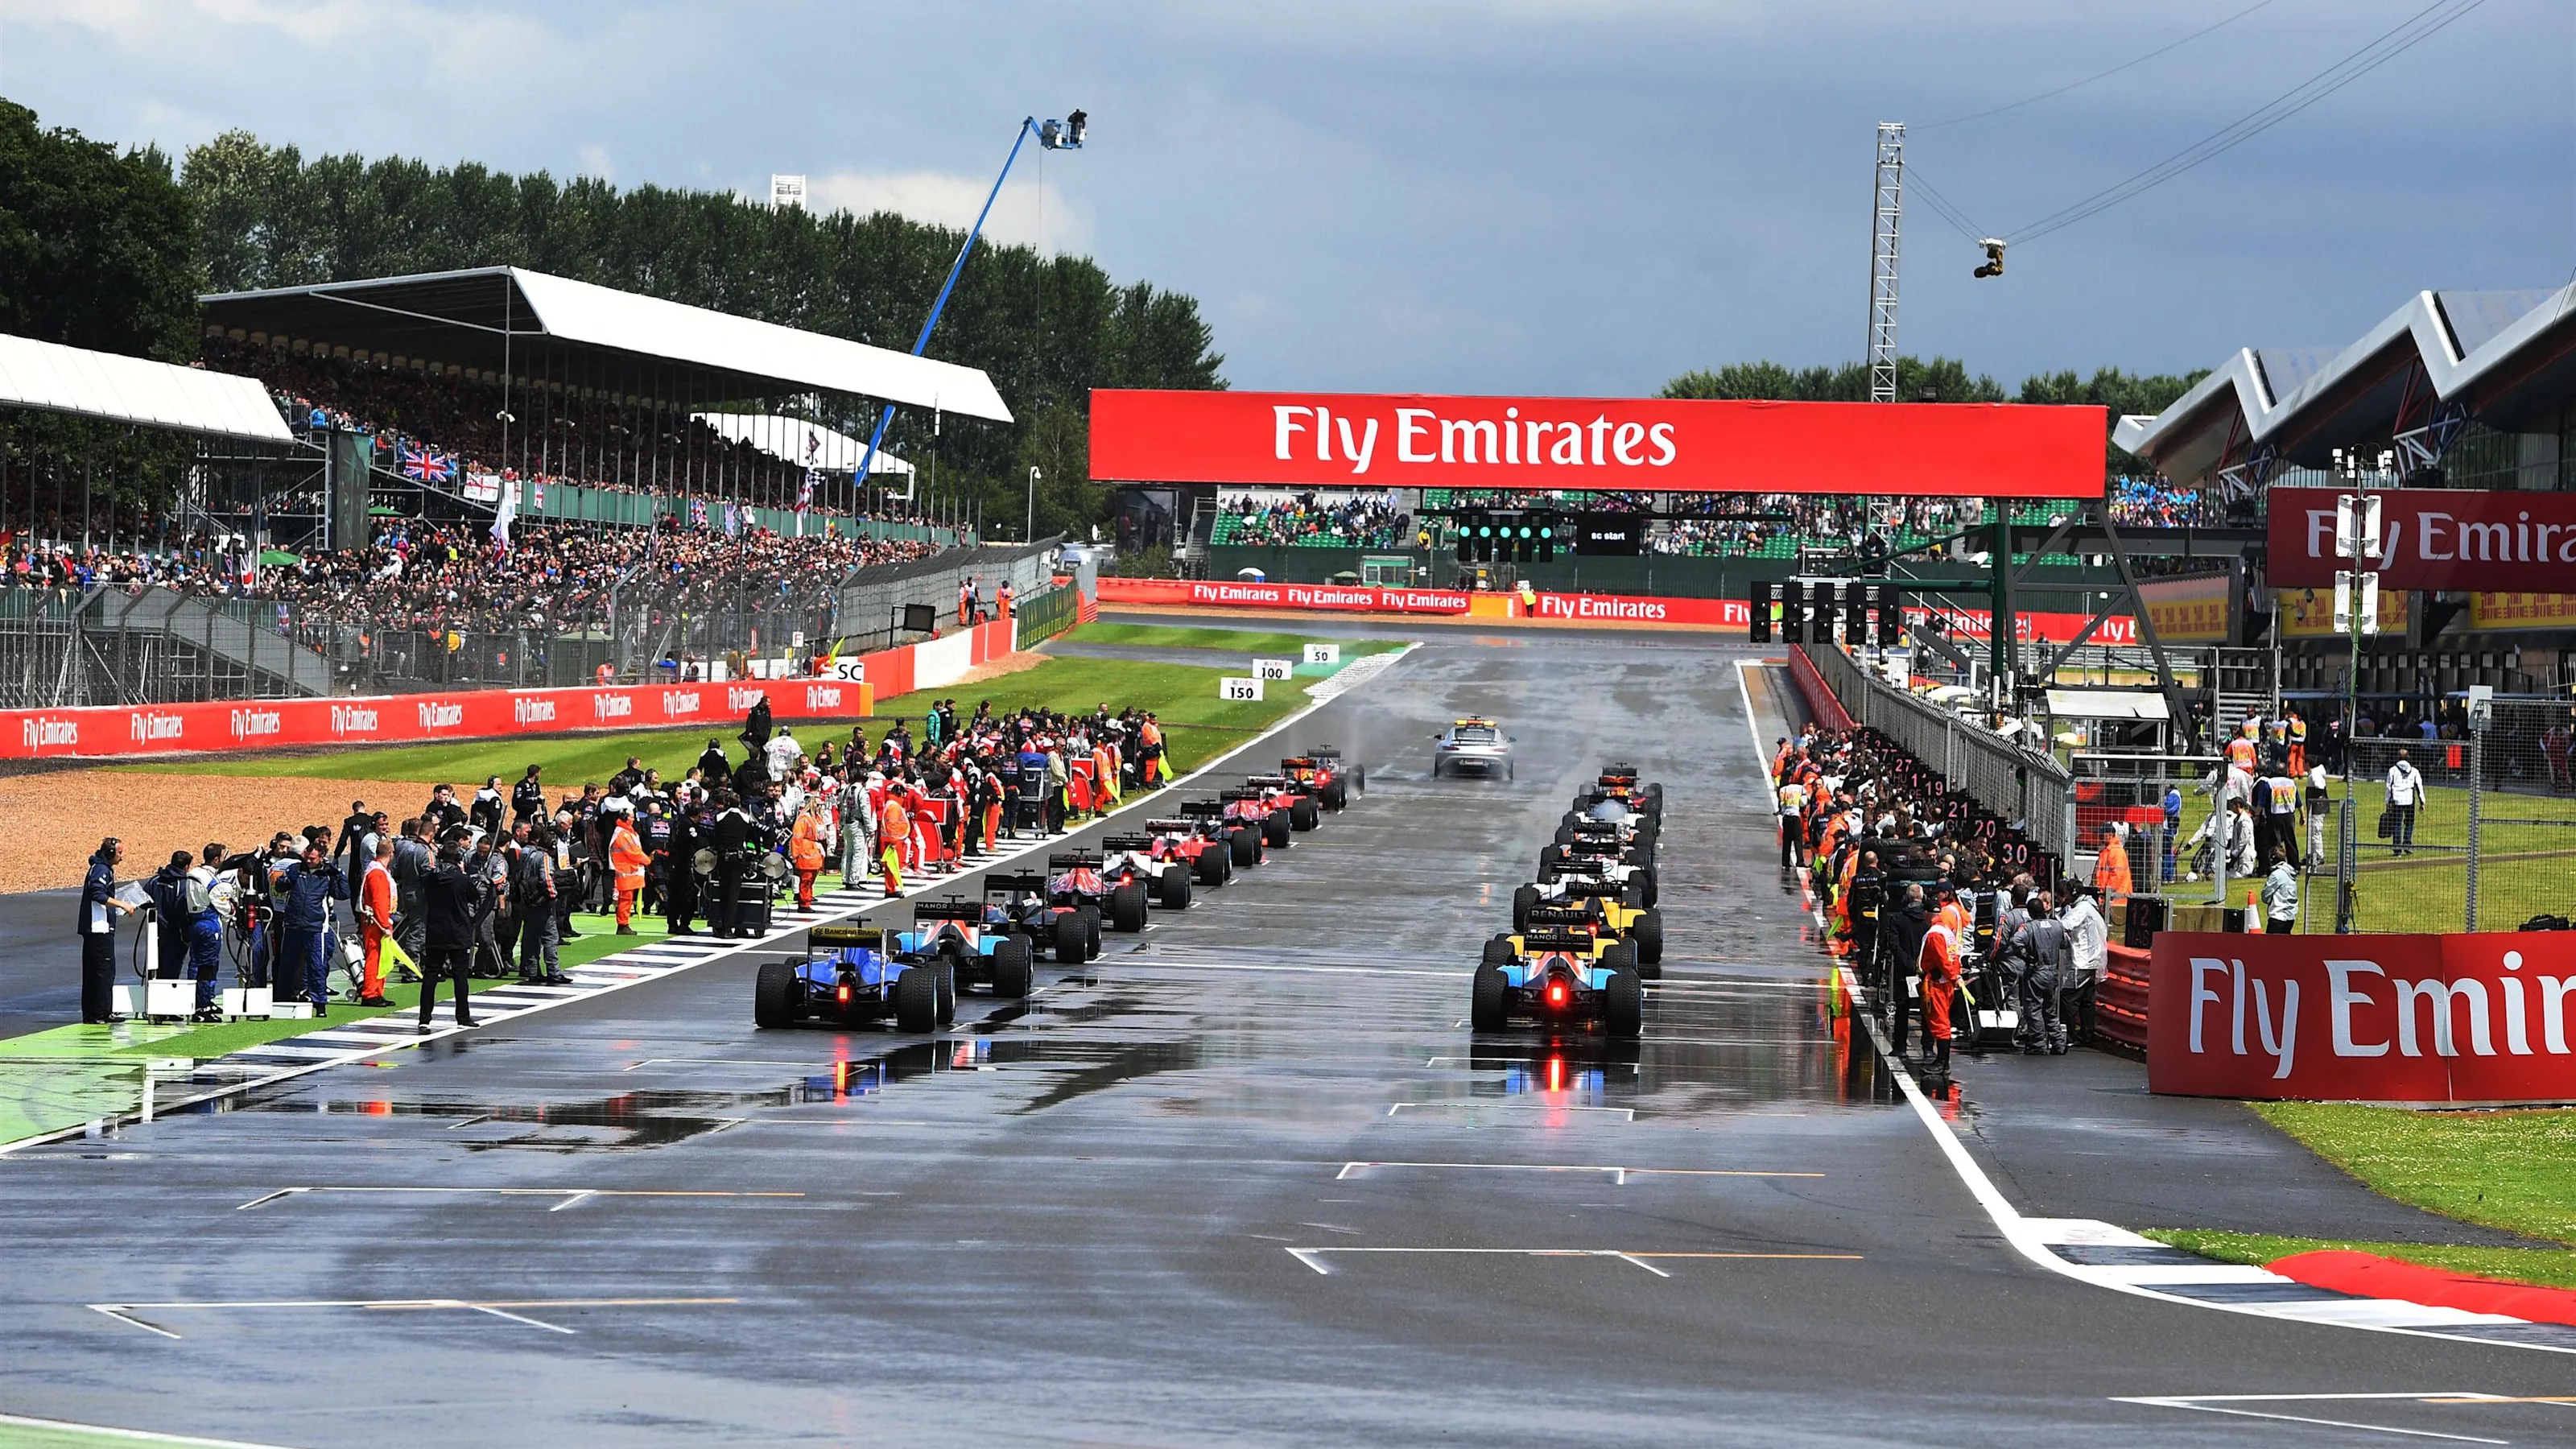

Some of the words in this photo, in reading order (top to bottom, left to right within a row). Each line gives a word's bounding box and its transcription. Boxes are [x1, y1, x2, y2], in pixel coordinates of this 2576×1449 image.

[1273, 406, 1379, 473] Fly
[1395, 407, 1677, 466] Emirates
[1604, 531, 1625, 540] start
[1194, 584, 1216, 602] Fly
[1220, 586, 1279, 602] Emirates
[1288, 588, 1311, 605] Fly
[1314, 589, 1373, 605] Emirates
[1382, 592, 1405, 609] Fly
[1408, 592, 1467, 609] Emirates
[1542, 596, 1575, 619] Fly
[1579, 597, 1666, 619] Emirates
[795, 634, 802, 645] F
[1314, 651, 1328, 661] 50
[838, 664, 863, 680] SC
[1261, 667, 1283, 679] 100
[729, 687, 739, 714] Fly
[807, 686, 818, 712] Fly
[817, 684, 841, 708] Emirates
[1230, 687, 1254, 699] 150
[514, 697, 526, 728] Fly
[526, 696, 555, 722] Emirates
[594, 694, 605, 723] Fly
[605, 692, 632, 716] Emirates
[663, 691, 675, 719] Fly
[675, 689, 700, 713] Emirates
[231, 709, 245, 741] Fly
[245, 706, 280, 735] Emirates
[331, 705, 345, 737] Fly
[345, 704, 378, 731] Emirates
[418, 702, 431, 733] Fly
[431, 700, 463, 726] Emirates
[23, 719, 39, 752] Fly
[39, 716, 78, 745] Emirates
[131, 713, 147, 745] Fly
[147, 712, 183, 739] Emirates
[1895, 758, 1912, 773] 27
[1926, 781, 1943, 796] 19
[1948, 801, 1968, 819] 21
[2002, 843, 2028, 865] 30
[1567, 883, 1620, 891] RENAULT
[949, 903, 980, 911] RACING
[1531, 910, 1587, 919] RENAULT
[2189, 957, 2300, 1080] Fly
[2322, 950, 2576, 1057] Emir
